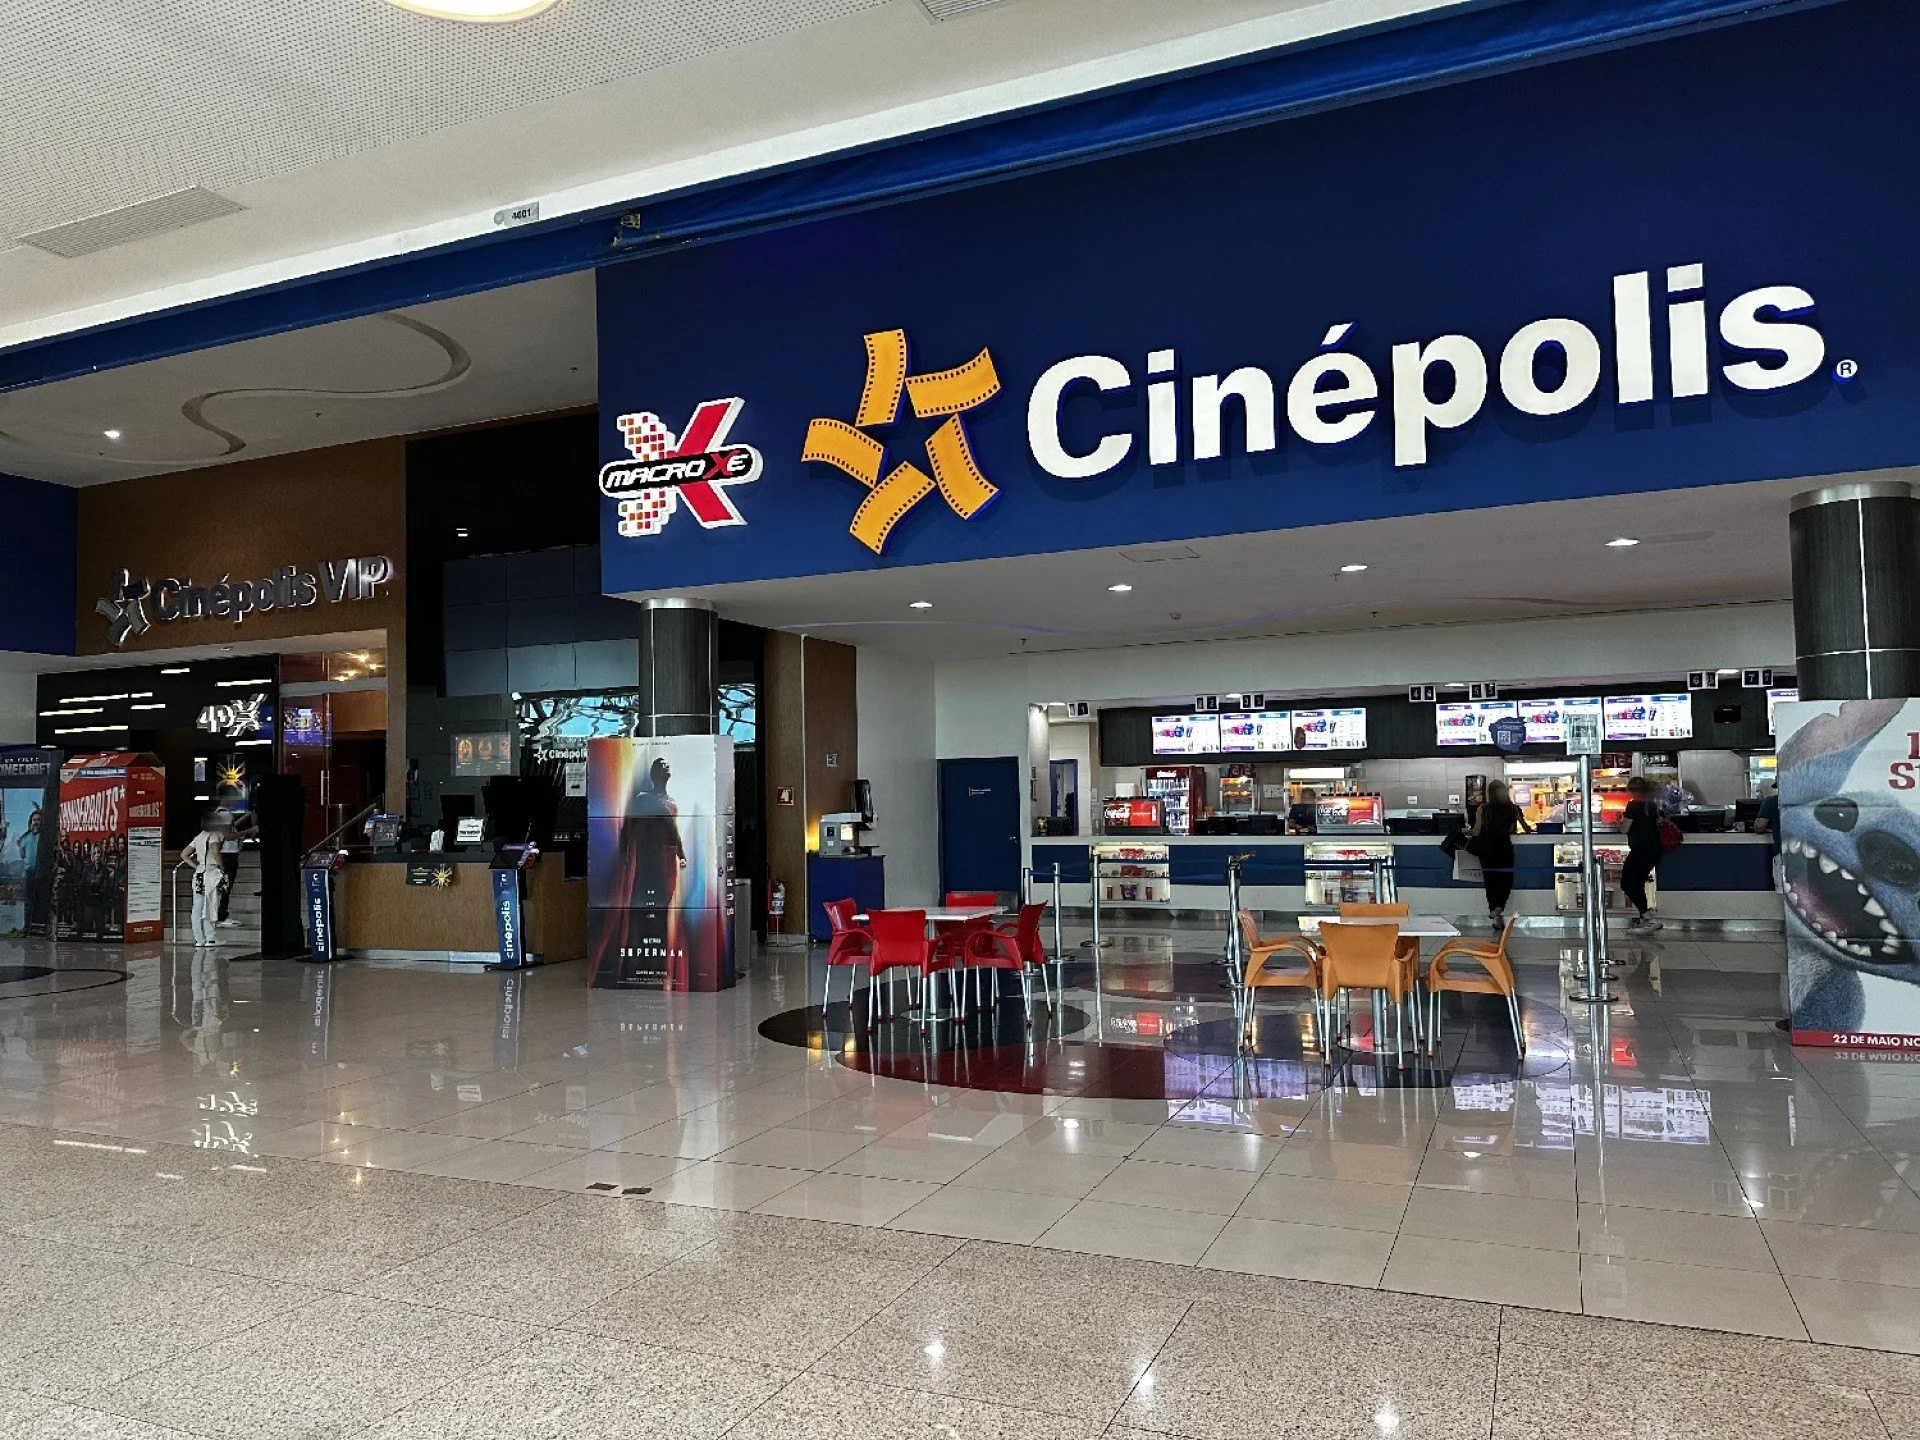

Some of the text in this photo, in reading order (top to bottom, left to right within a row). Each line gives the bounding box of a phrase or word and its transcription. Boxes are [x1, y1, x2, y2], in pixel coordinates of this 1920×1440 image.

[1027, 263, 1826, 470] Cinépolis
[152, 556, 391, 625] Cinépolis VIP
[620, 947, 683, 958] SUPERMAN
[1832, 1033, 1848, 1044] 22
[1850, 1035, 1865, 1045] DE
[1866, 1036, 1901, 1047] MAIO
